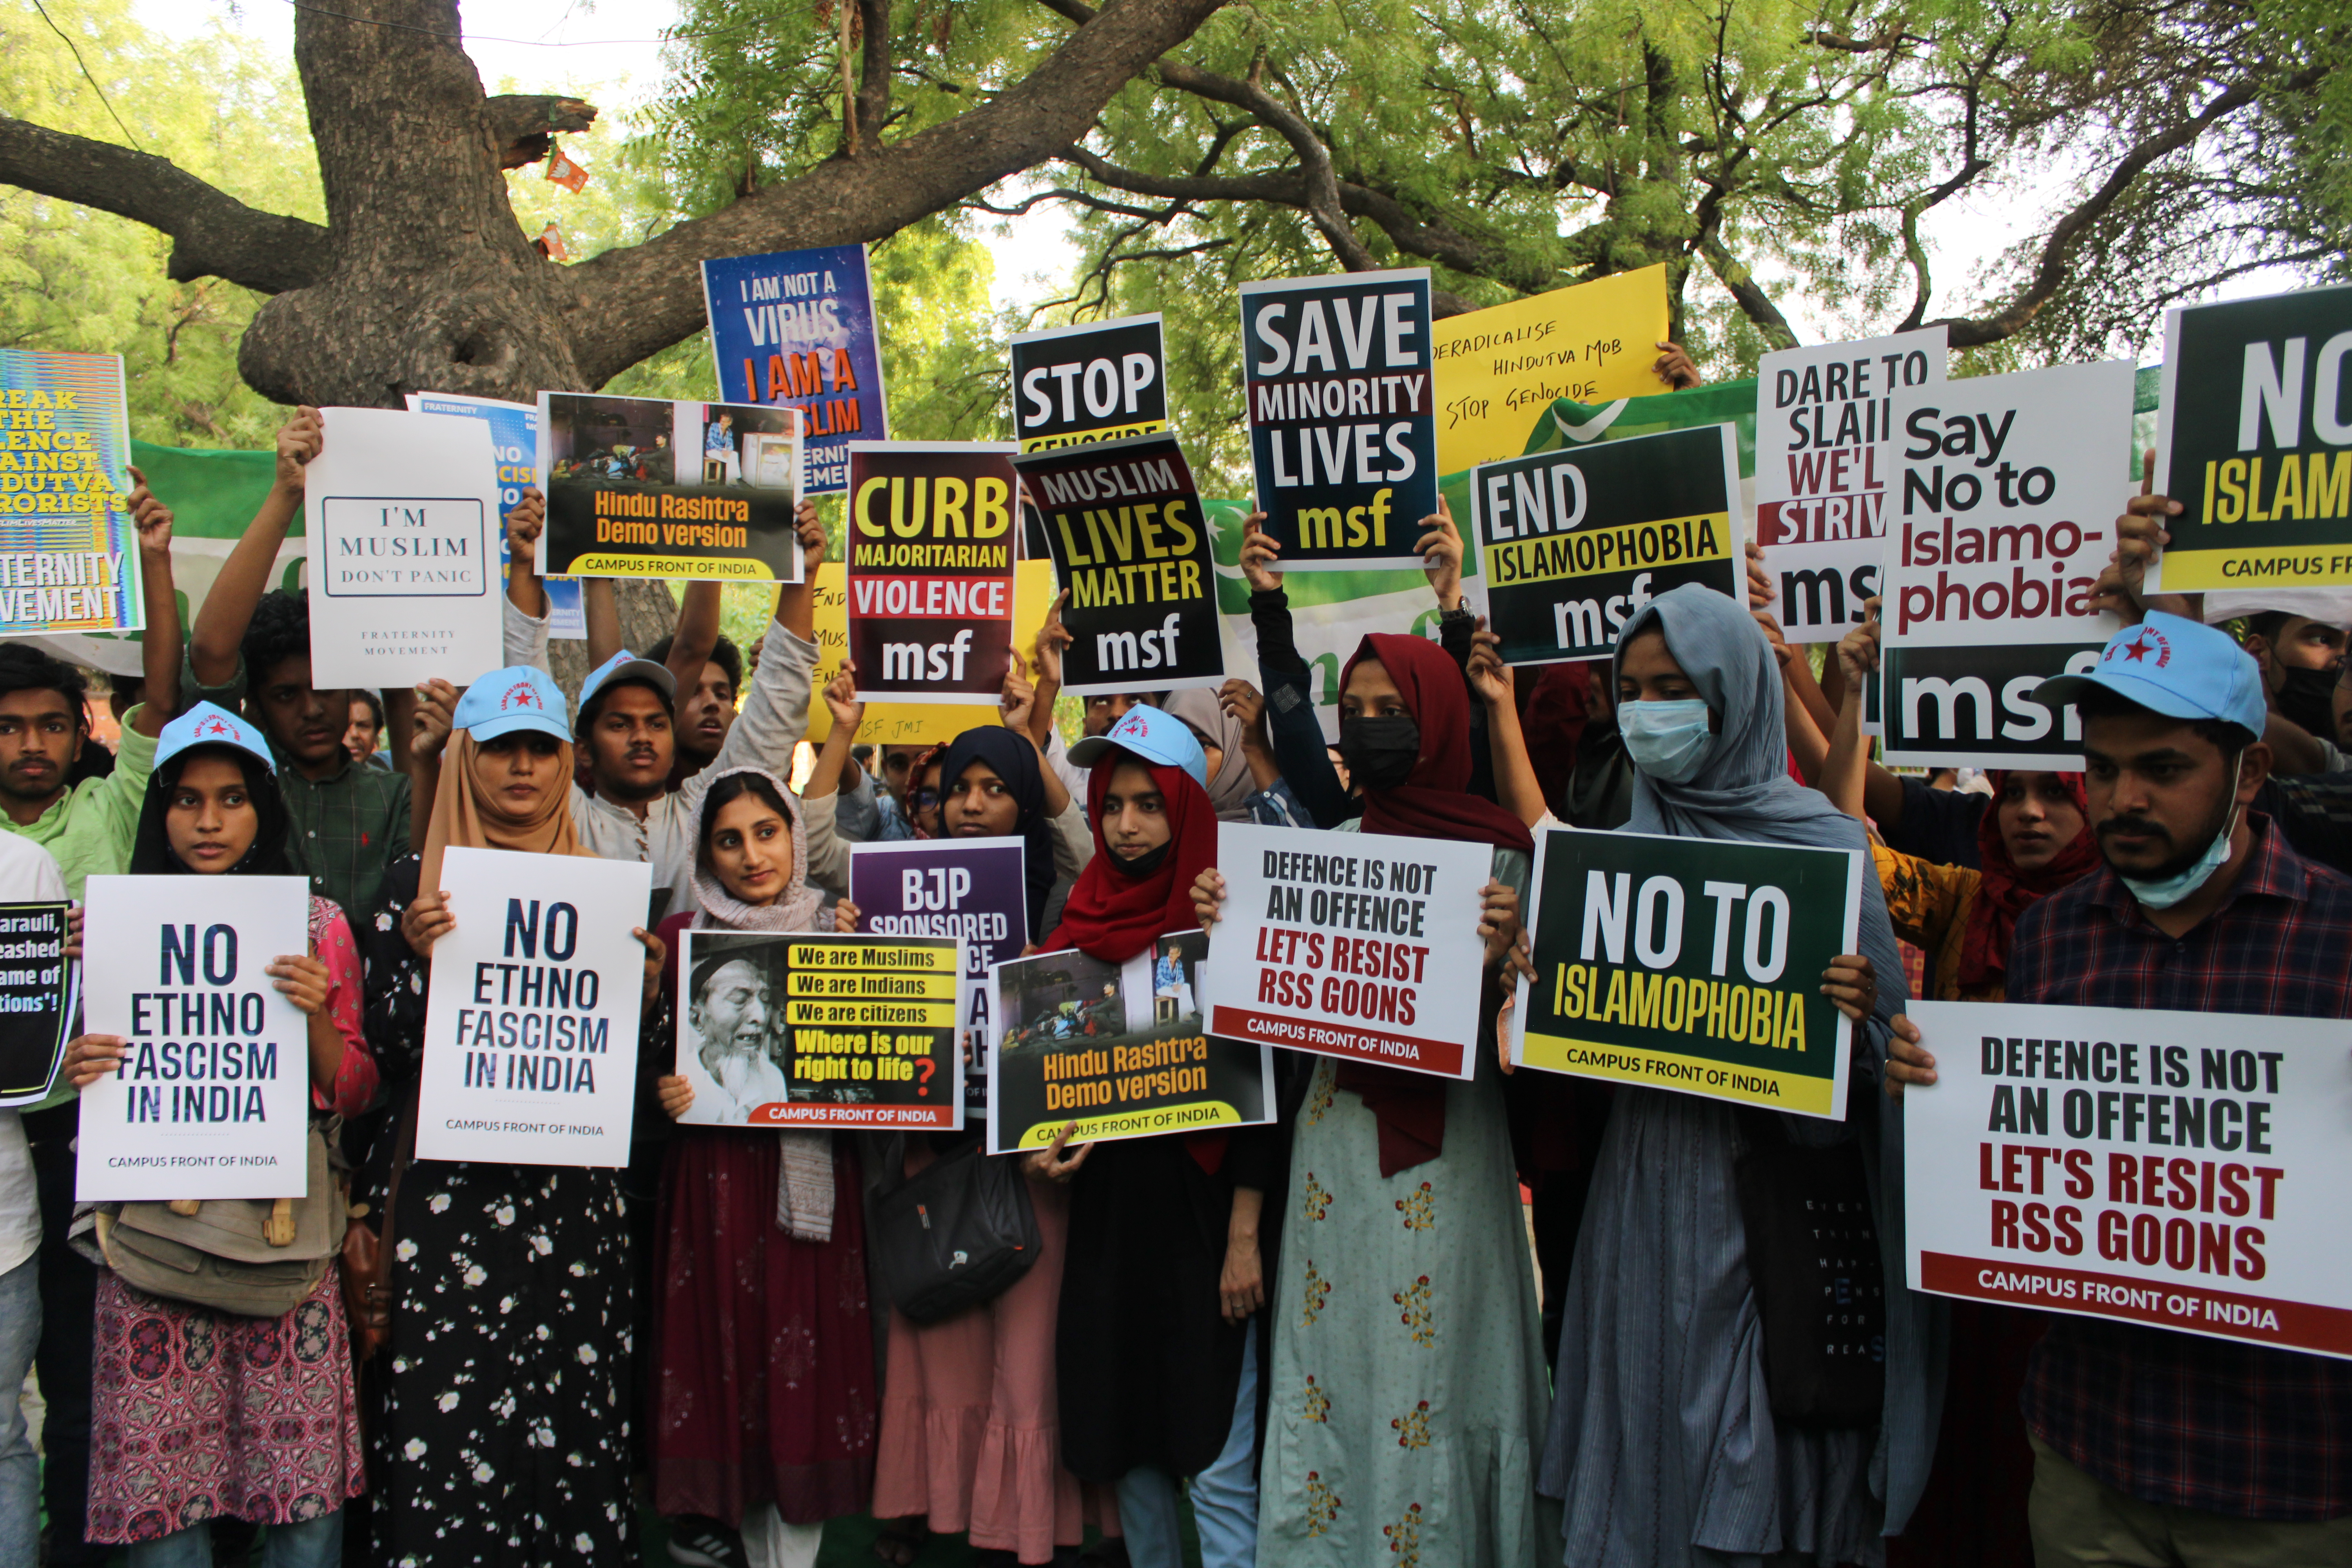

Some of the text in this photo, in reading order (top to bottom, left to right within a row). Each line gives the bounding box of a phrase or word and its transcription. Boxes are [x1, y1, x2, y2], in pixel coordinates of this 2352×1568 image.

[740, 271, 836, 302] I AM NOT A
[744, 298, 840, 347] VIRUS
[1255, 292, 1418, 376] SAVE
[744, 348, 858, 402] I AM A
[1494, 339, 1622, 375] HINDUTVA MOB
[1775, 350, 1927, 408] DARE TO
[424, 403, 477, 414] FRATERNITY
[1022, 352, 1155, 428] STOP
[1258, 374, 1425, 421] MINORITY
[1446, 380, 1598, 429] STOP GENOCIDE
[1270, 422, 1416, 486] LIVES
[1904, 408, 2016, 467] Say
[1041, 459, 1179, 505] MUSLIM
[1487, 463, 1587, 540] END
[1903, 461, 2055, 515] No to
[2202, 451, 2352, 525] ISLAM
[380, 508, 427, 527] I'M
[595, 491, 748, 521] Hindu Rashtra
[855, 477, 1009, 538] CURB
[1297, 488, 1392, 548] msf
[339, 537, 468, 557] MUSLIM
[597, 519, 747, 548] Demo version
[855, 544, 1007, 568] MAJORITARIAN
[1056, 501, 1197, 566] LIVES
[1493, 519, 1719, 583] ISLAMOPHOBIA
[1901, 517, 2102, 567] Islamo-
[341, 570, 470, 583] DON'T PANIC
[585, 559, 756, 574] CAMPUS FRONT OF INDIA
[1072, 560, 1202, 608] MATTER
[2222, 557, 2323, 577] CAMPUS
[854, 580, 1004, 615] VIOLENCE
[1898, 562, 2100, 635] phobia
[361, 631, 456, 640] FRATERNITY
[365, 647, 448, 655] MOVEMENT
[883, 630, 973, 681] msf
[1097, 613, 1180, 671] msf
[891, 720, 924, 739] JMI
[902, 867, 971, 911] BJP
[1263, 850, 1437, 895] DEFENCE IS NOT
[503, 898, 578, 962] NO
[870, 913, 1007, 941] SPONSORED
[1266, 886, 1425, 938] AN OFFENCE
[1580, 869, 1790, 983] NO TO
[41, 965, 61, 985] of
[161, 924, 238, 986] NO
[798, 948, 935, 967] We are Muslims
[1256, 927, 1429, 984] LET'S RESIST
[473, 962, 599, 1011] ETHNO
[797, 976, 926, 995] We are Indians
[1258, 968, 1416, 1026] RSS GOONS
[1553, 962, 1806, 1052] ISLAMOPHOBIA
[132, 993, 264, 1036] ETHNO
[456, 1009, 609, 1054] FASCISM
[797, 1004, 927, 1023] We are citizens
[117, 1042, 276, 1081] FASCISM
[795, 1030, 933, 1055] Where is our
[1044, 1036, 1207, 1081] Hindu Rashtra
[1247, 1019, 1420, 1060] CAMPUS FRONT OF INDIA
[464, 1051, 595, 1094] IN INDIA
[795, 1057, 846, 1082] right
[851, 1059, 873, 1080] to
[1567, 1048, 1780, 1097] CAMPUS FRONT OF INDIA
[1981, 1036, 2284, 1094] DEFENCE IS NOT
[127, 1086, 266, 1123] IN INDIA
[1046, 1066, 1207, 1111] Demo version
[445, 1119, 604, 1136] CAMPUS FRONT OF INDIA
[769, 1107, 936, 1122] CAMPUS FRONT OF INDIA
[1036, 1107, 1220, 1142] CAPUS FRONT OF INDIA
[1988, 1084, 2271, 1154] AN OFFENCE
[109, 1156, 277, 1167] CAMPUS FRONT OF INDIA
[1980, 1142, 2284, 1221] LET'S RESIST
[1991, 1199, 2265, 1281] RSS GOONS
[1826, 1314, 1865, 1325] FOR
[1978, 1270, 2279, 1331] CAMPUS FRONT OF INDIA
